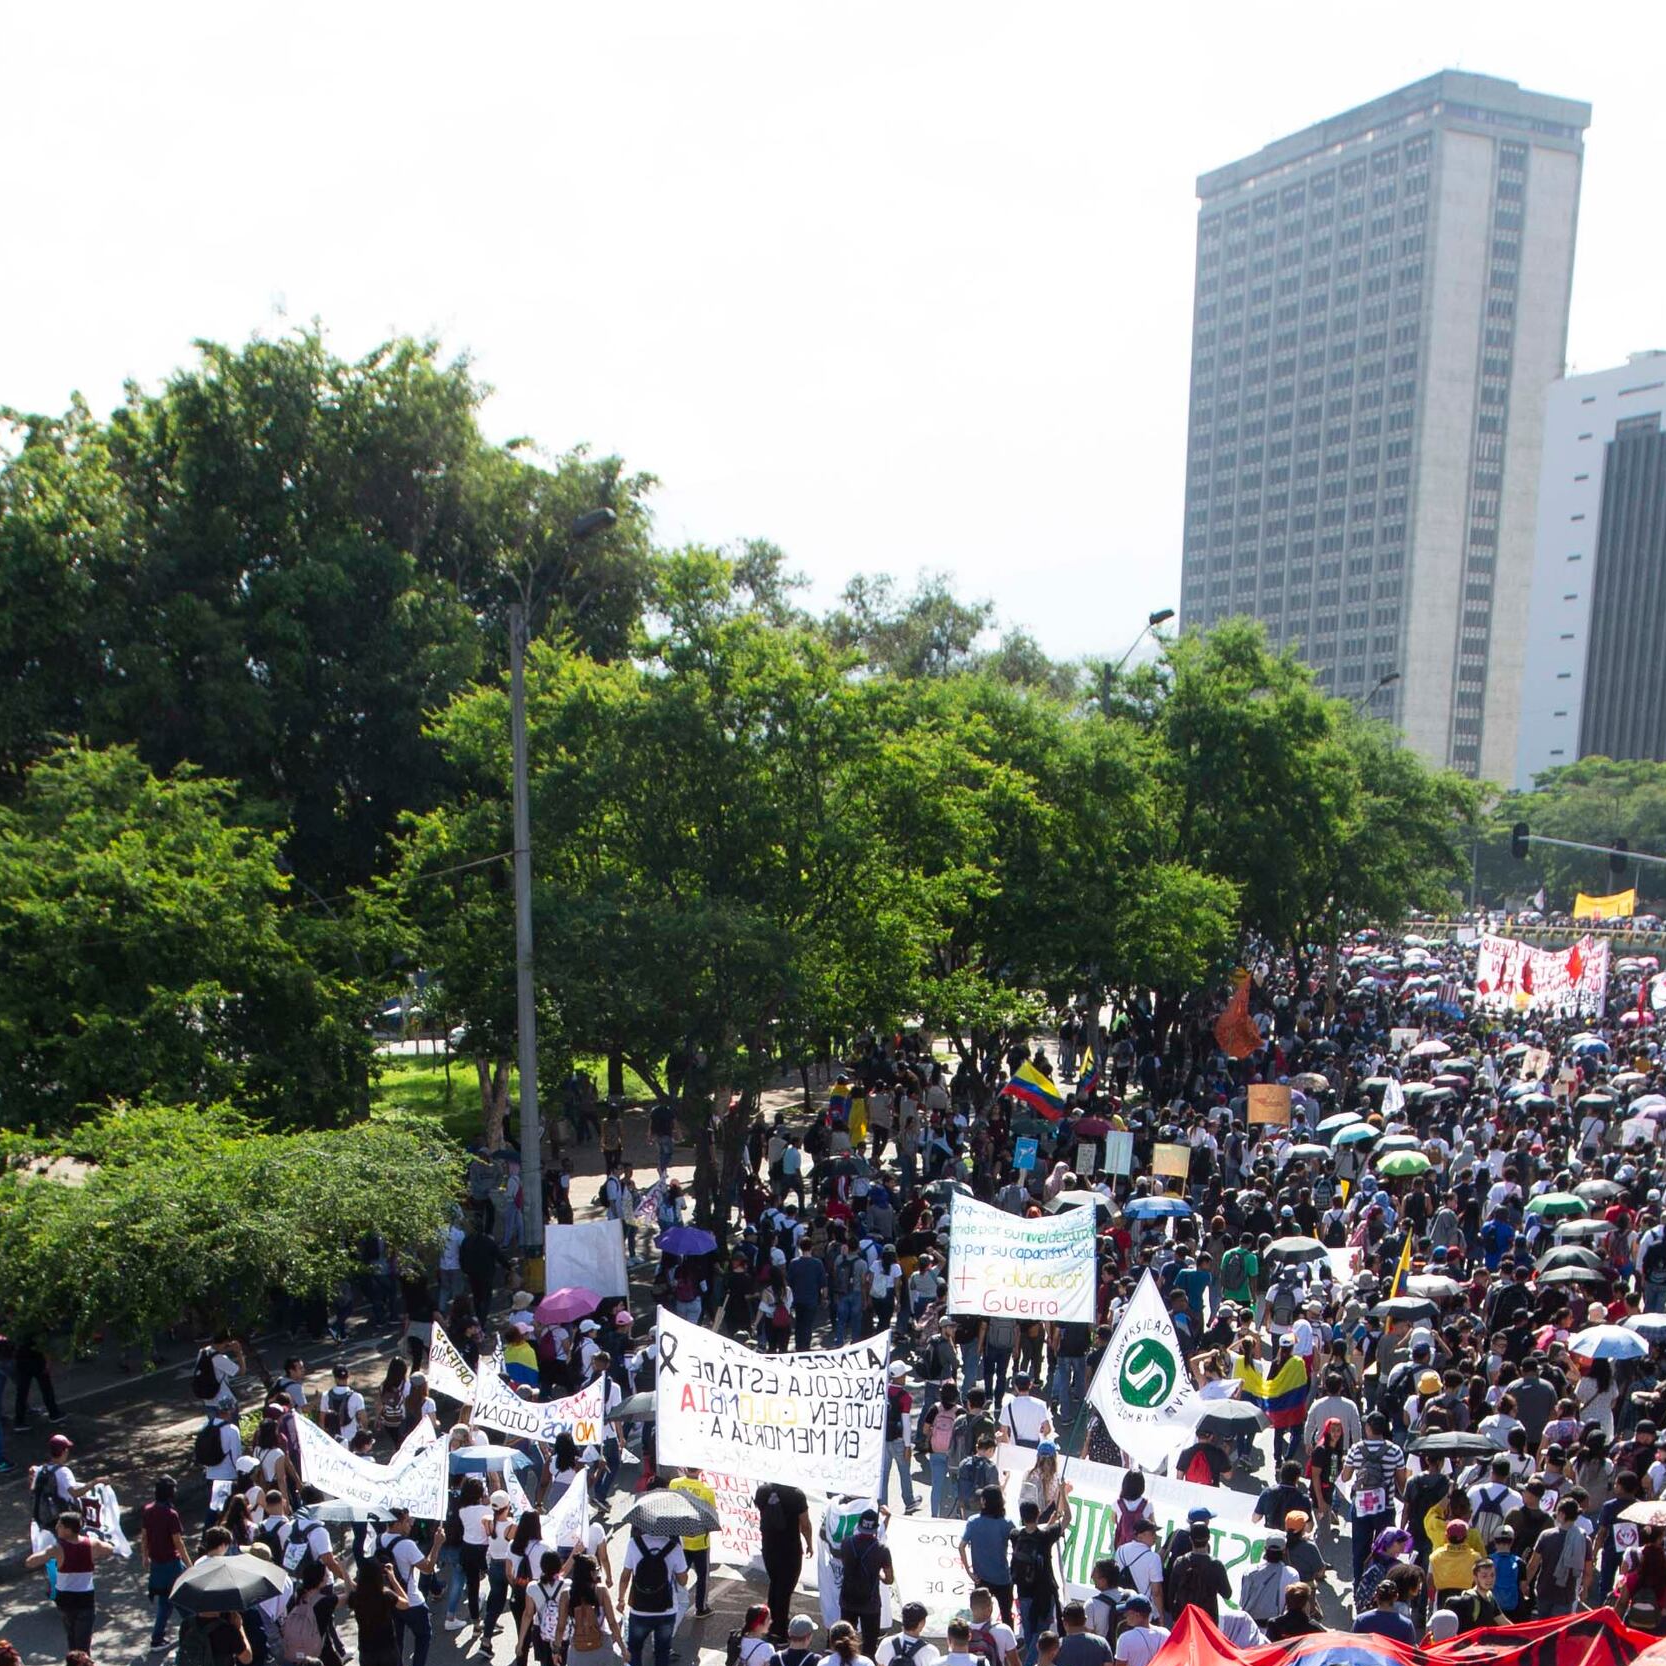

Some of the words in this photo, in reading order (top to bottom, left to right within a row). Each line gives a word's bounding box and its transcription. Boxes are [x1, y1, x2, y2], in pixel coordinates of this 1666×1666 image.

[965, 1244, 986, 1262] por
[991, 1245, 1008, 1258] su
[982, 1289, 1059, 1316] Guerra
[1114, 1319, 1173, 1369] UNIVERSIDAD
